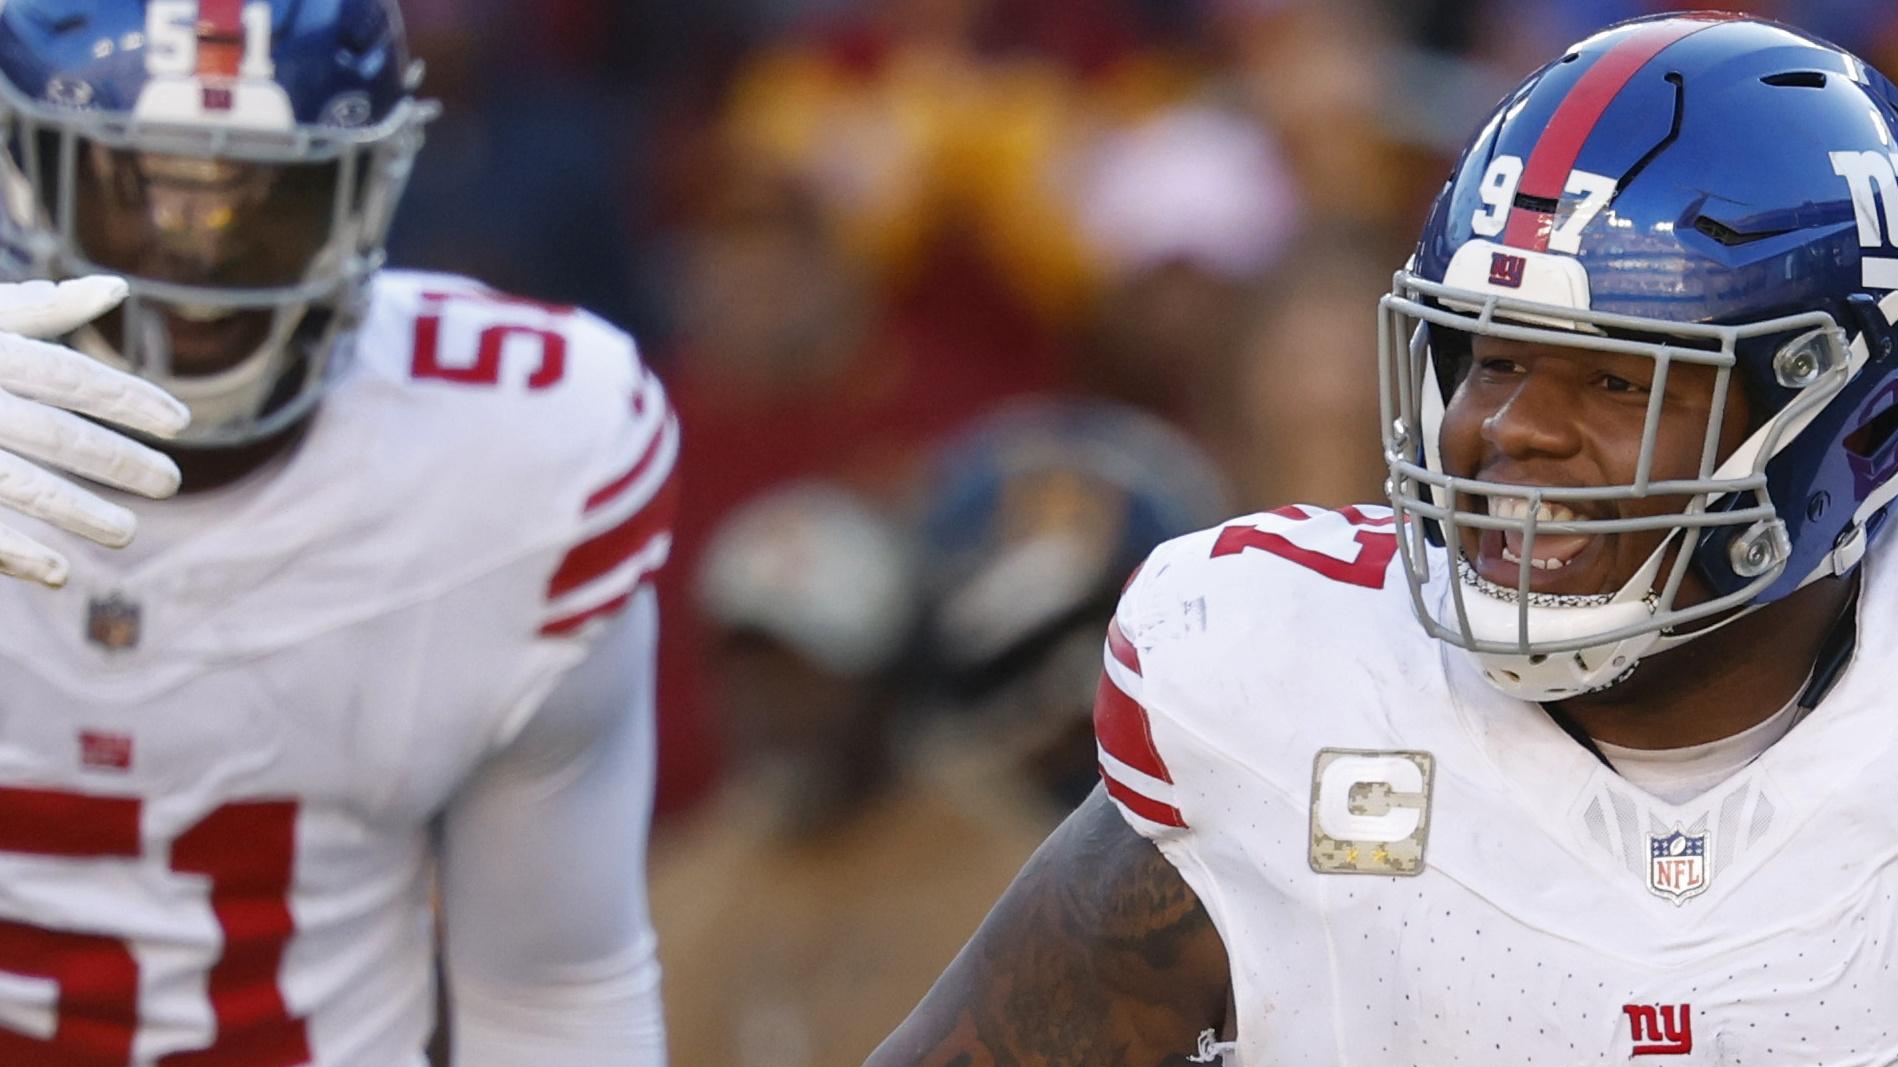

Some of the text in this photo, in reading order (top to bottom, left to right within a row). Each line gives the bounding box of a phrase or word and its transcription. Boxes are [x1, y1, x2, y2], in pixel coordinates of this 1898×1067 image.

[144, 0, 275, 80] 51
[1471, 155, 1618, 254] 97
[1318, 757, 1424, 842] C
[1657, 859, 1700, 889] NFL
[1622, 1003, 1692, 1055] ny
